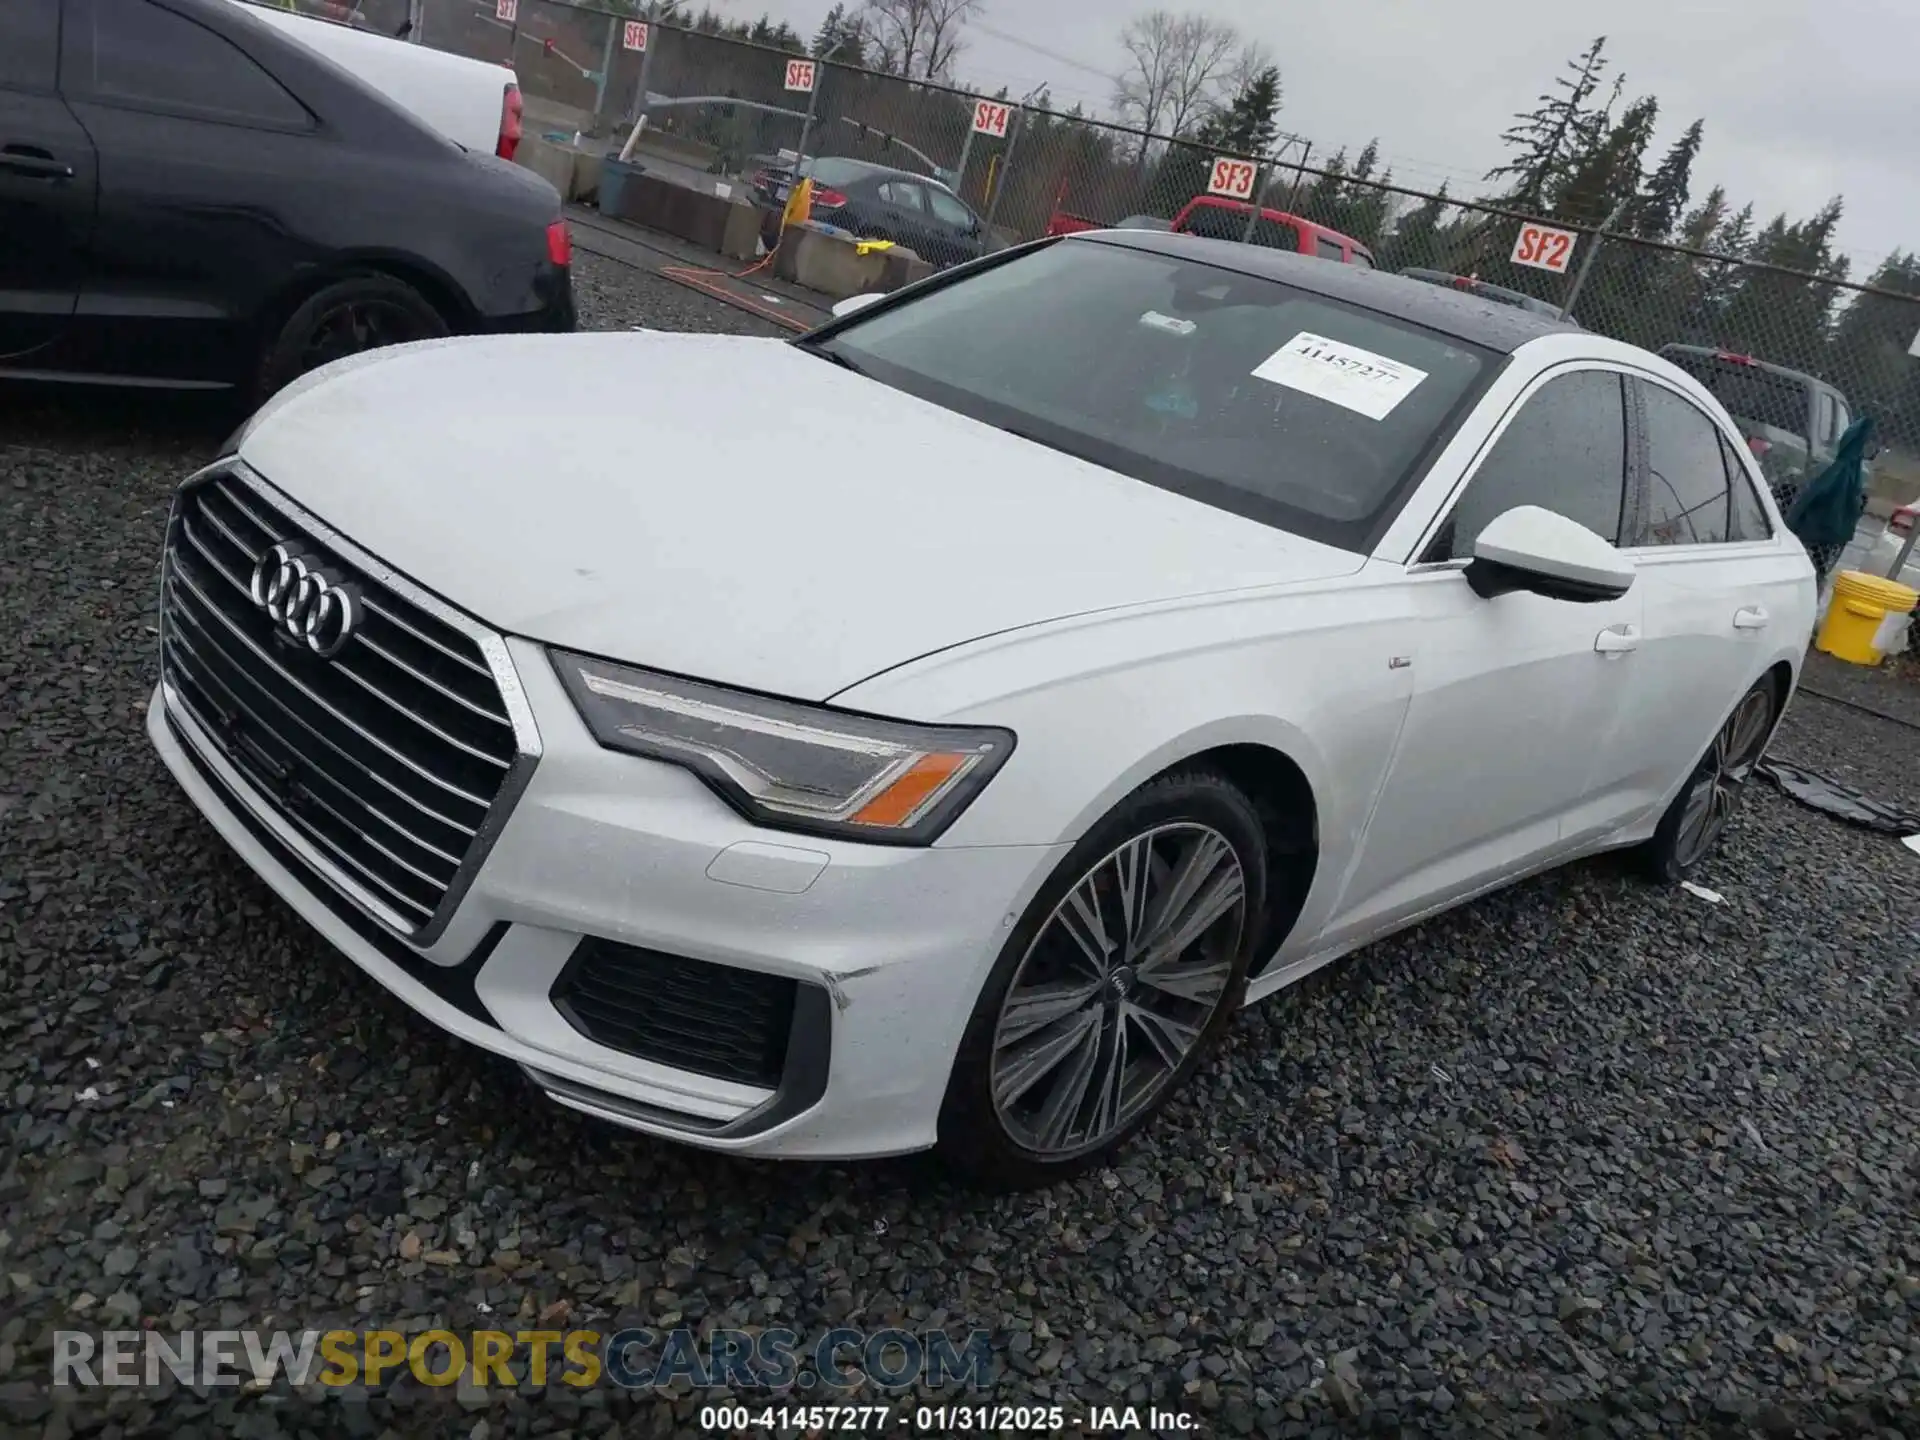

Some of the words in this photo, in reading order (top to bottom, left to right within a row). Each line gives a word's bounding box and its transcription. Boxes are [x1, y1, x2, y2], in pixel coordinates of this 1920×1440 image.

[626, 24, 645, 47] SF6
[788, 63, 811, 87] SF5
[976, 103, 1005, 133] SF4
[1213, 161, 1253, 194] SF3
[1518, 228, 1569, 268] SF2
